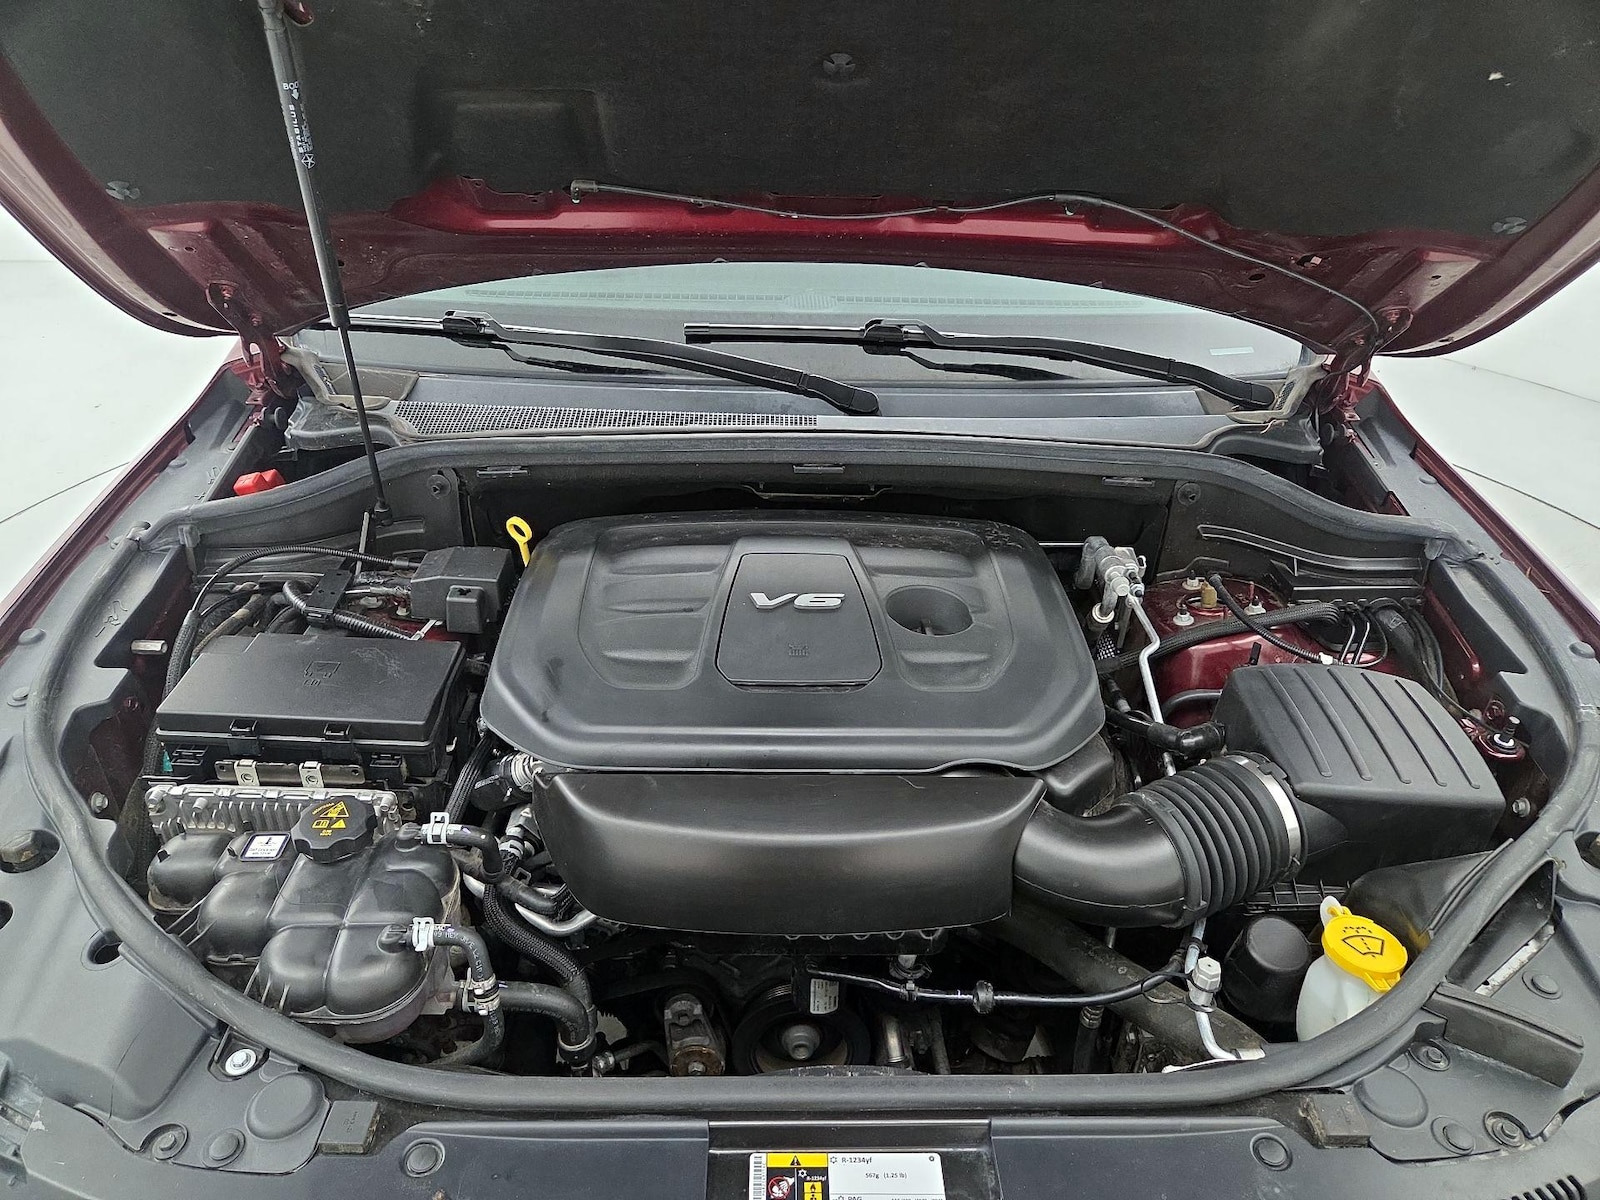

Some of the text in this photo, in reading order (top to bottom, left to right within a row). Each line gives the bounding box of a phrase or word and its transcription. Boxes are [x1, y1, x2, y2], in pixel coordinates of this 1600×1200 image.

[288, 104, 304, 154] STABILUS
[750, 592, 845, 610] V6
[841, 1156, 873, 1165] R-1234yf
[865, 1172, 880, 1180] 567g
[883, 1172, 898, 1180] (1.25
